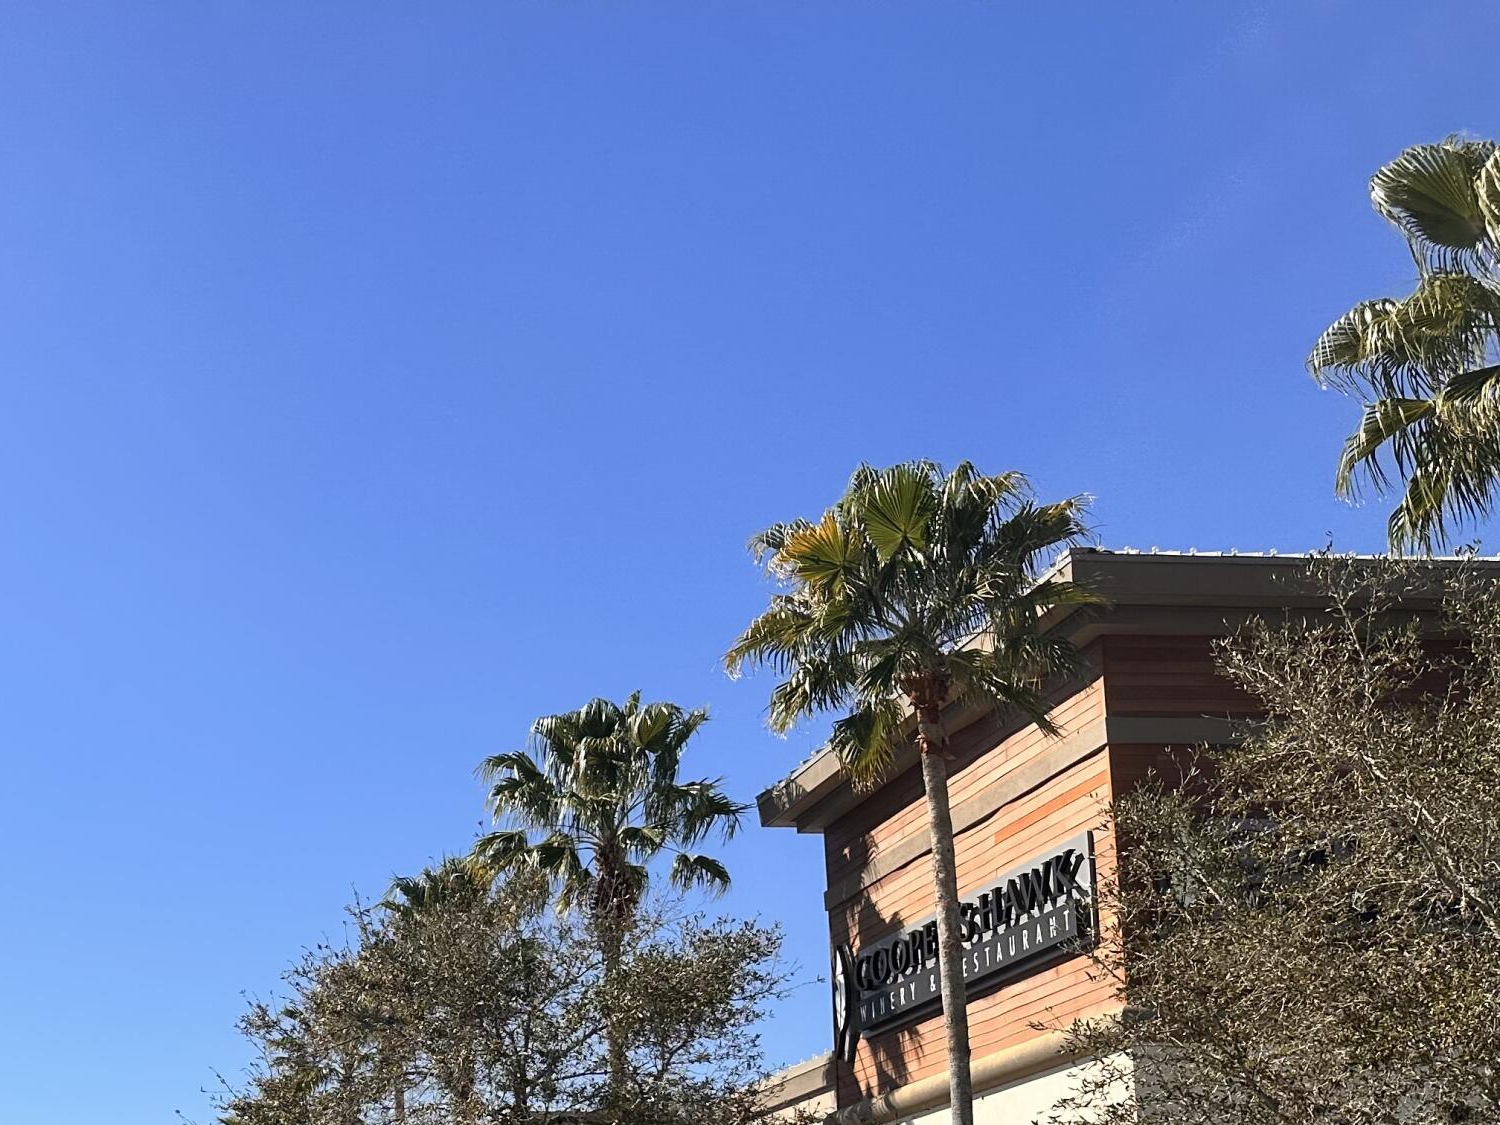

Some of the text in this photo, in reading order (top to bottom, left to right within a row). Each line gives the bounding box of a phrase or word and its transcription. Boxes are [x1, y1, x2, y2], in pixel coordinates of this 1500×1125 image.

[977, 849, 1091, 932] HAWK
[860, 909, 1070, 1024] WINERY & ESTAURANT
